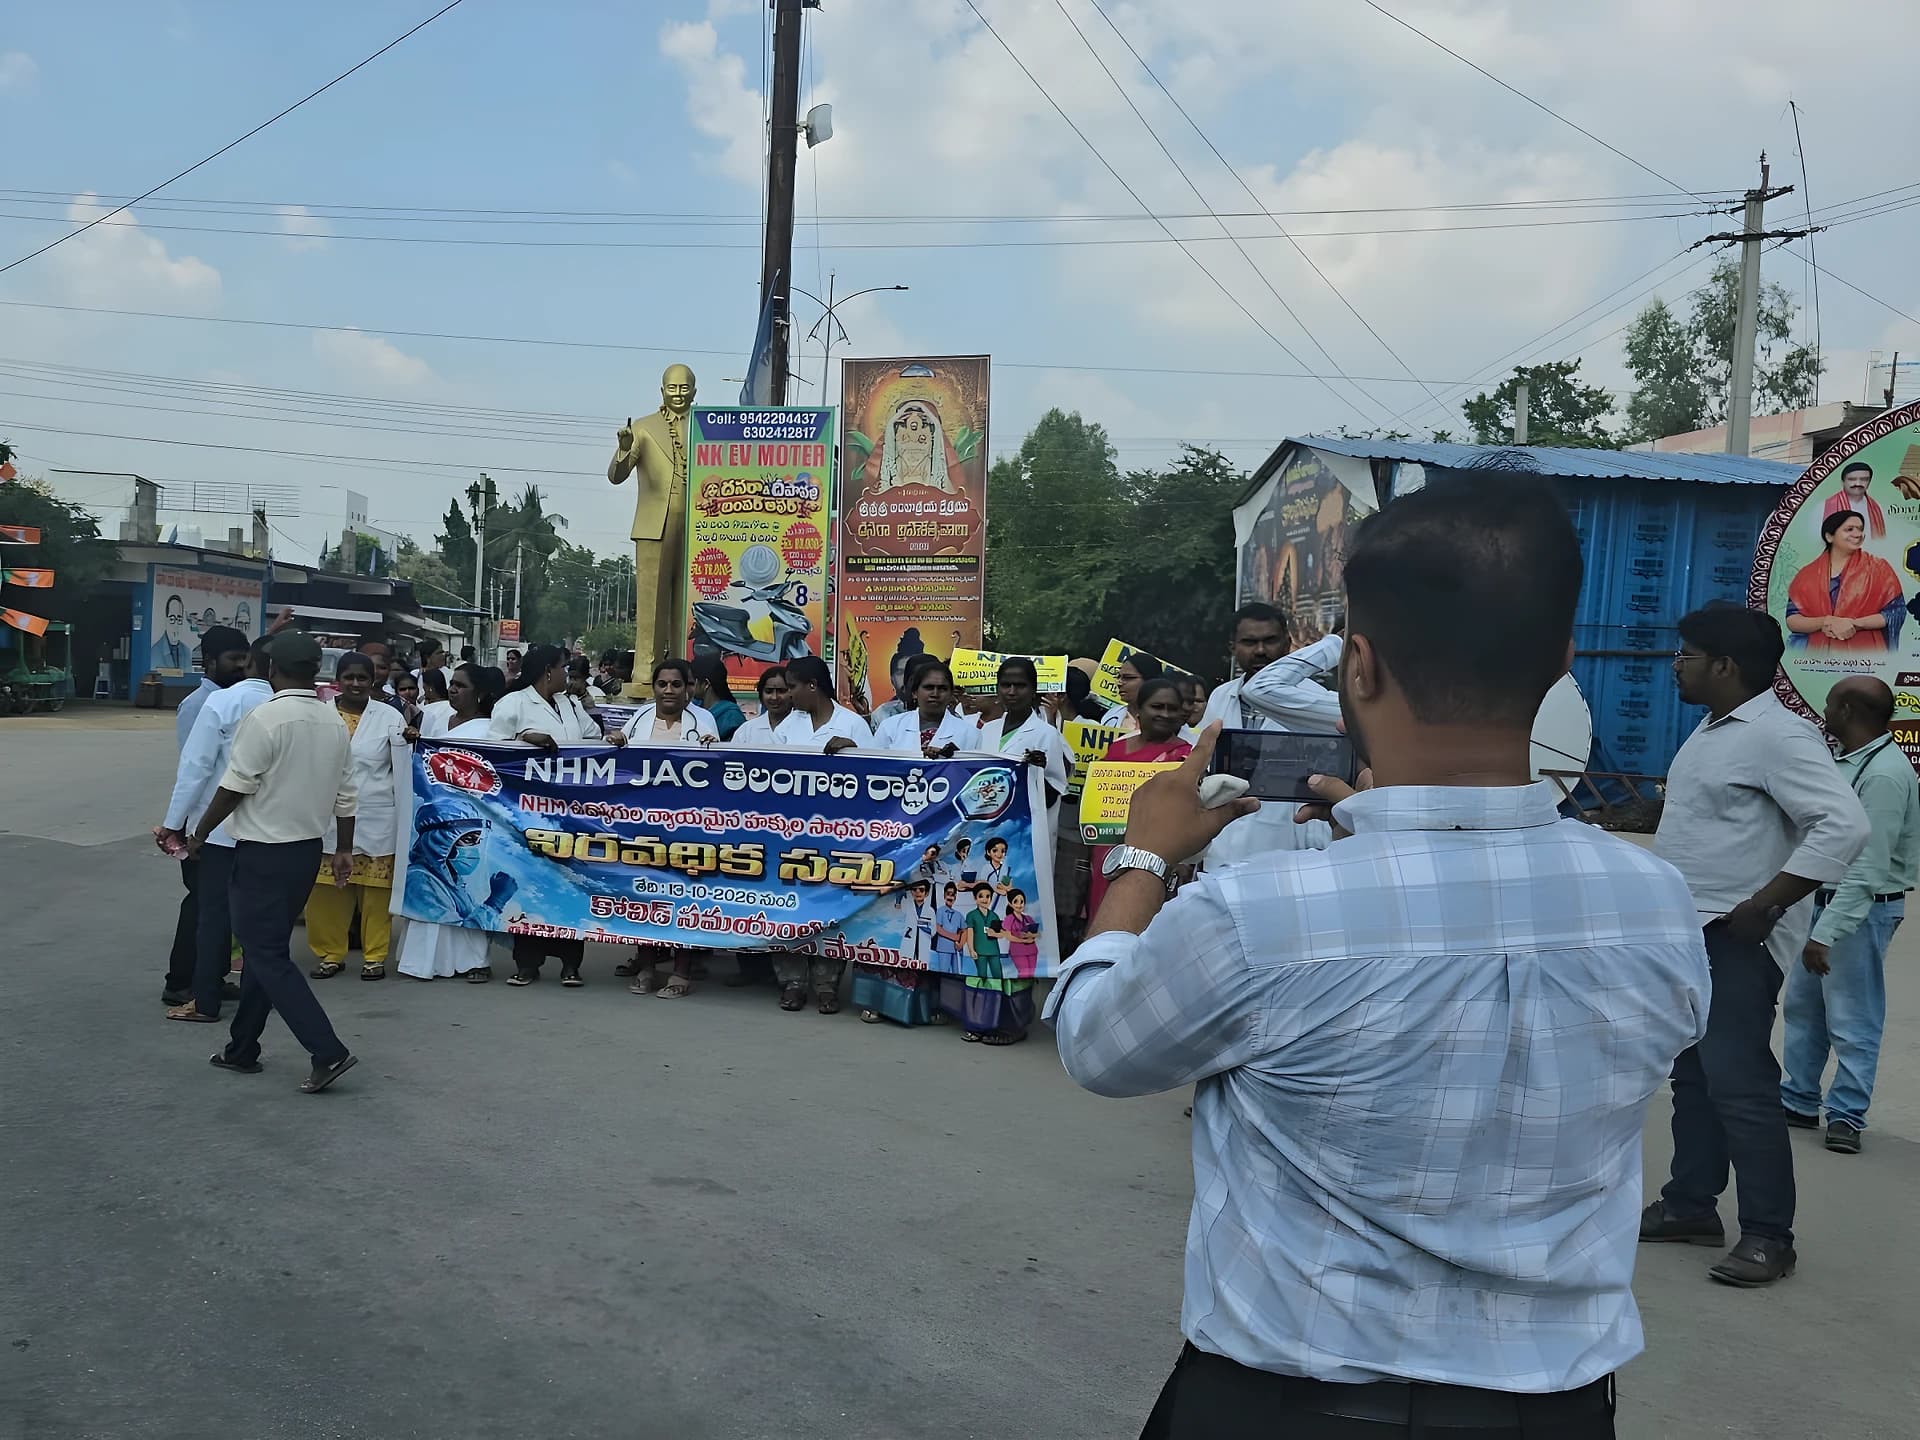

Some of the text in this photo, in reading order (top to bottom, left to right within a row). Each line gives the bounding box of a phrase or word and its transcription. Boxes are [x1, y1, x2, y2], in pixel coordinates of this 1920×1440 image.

[696, 444, 826, 467] NK EV MOTER
[1080, 728, 1126, 750] NH
[523, 757, 617, 786] NHM
[629, 759, 711, 788] JAC
[722, 761, 859, 799] తెలంగాణ
[520, 794, 566, 815] NHM
[647, 808, 740, 833] న్యాయమైన
[744, 811, 804, 838] హక్కుల
[809, 814, 865, 841] సాధన
[525, 828, 764, 877] నిరవధిక
[591, 895, 674, 925] కోవిడ్
[759, 894, 798, 909] నుండి
